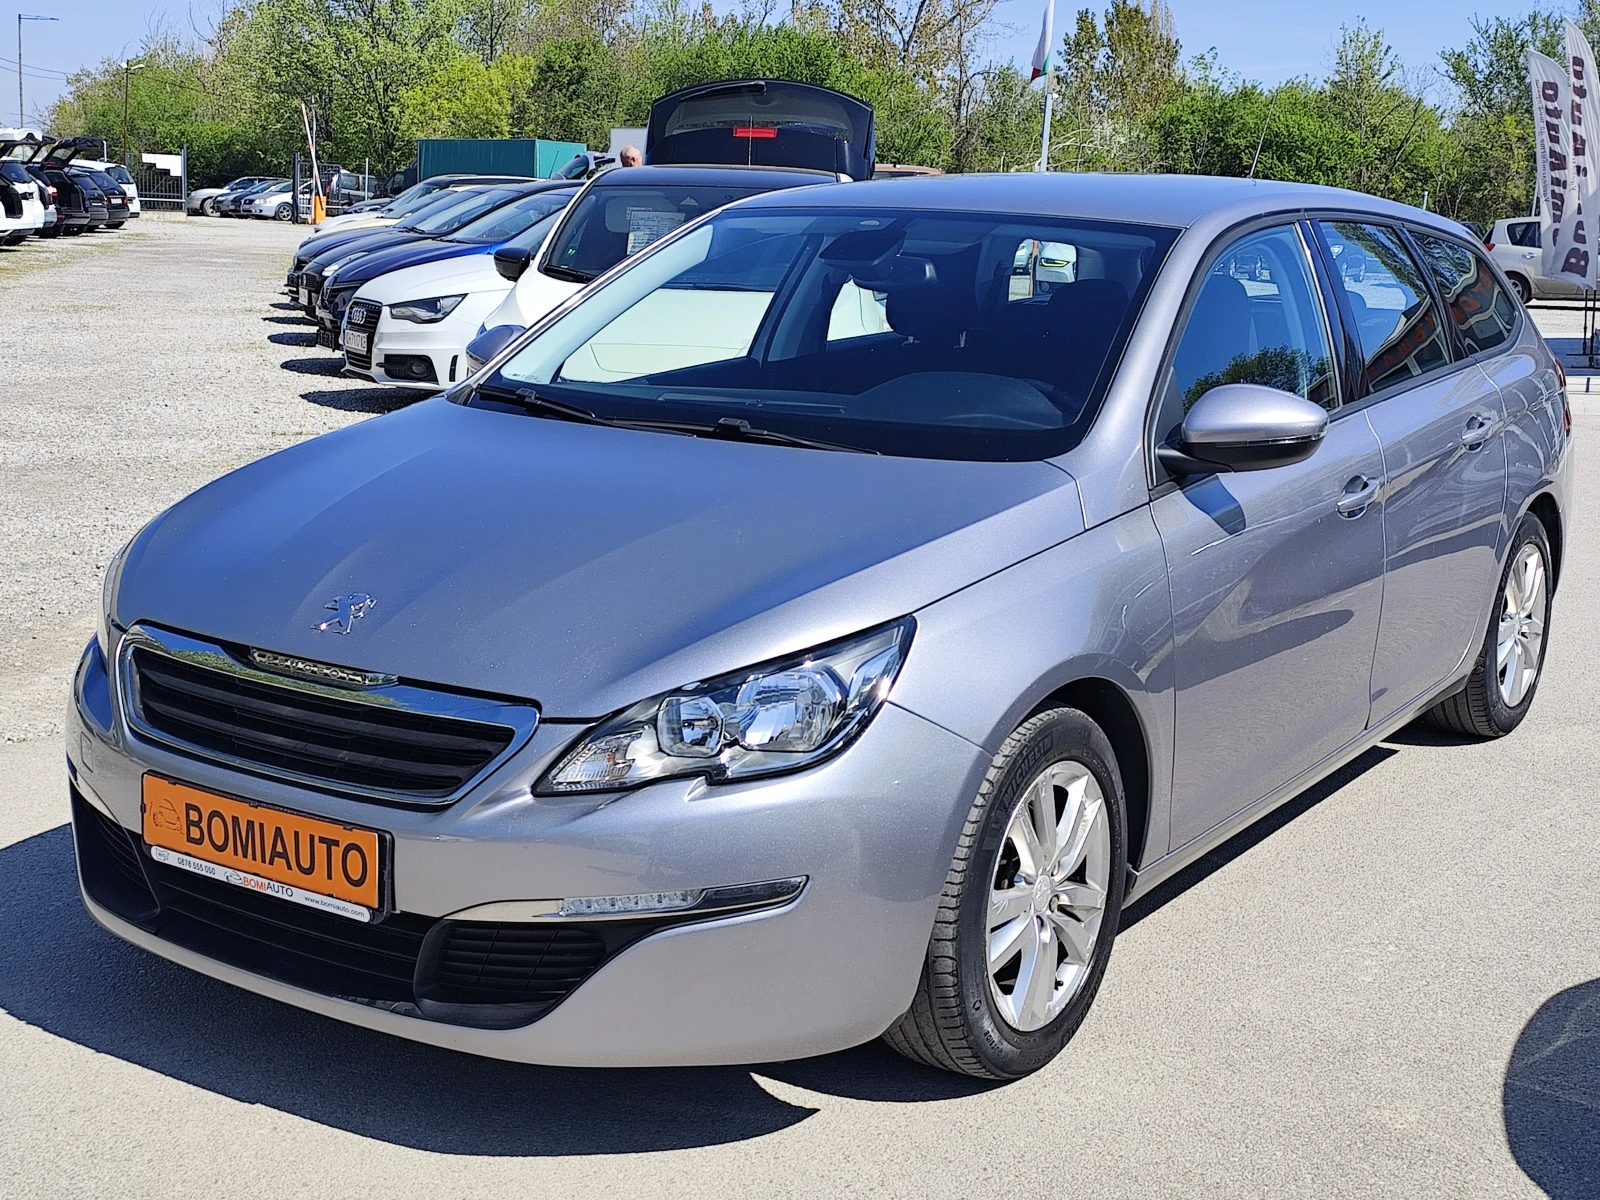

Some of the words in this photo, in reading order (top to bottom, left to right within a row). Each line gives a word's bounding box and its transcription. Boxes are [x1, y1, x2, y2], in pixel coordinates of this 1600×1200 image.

[185, 802, 368, 888] BOMIAUTO
[177, 857, 192, 868] 0878
[192, 862, 204, 872] 555
[204, 865, 216, 875] 050
[243, 877, 294, 897] BOMIAUTO
[303, 896, 365, 918] www.bomiauto.com
